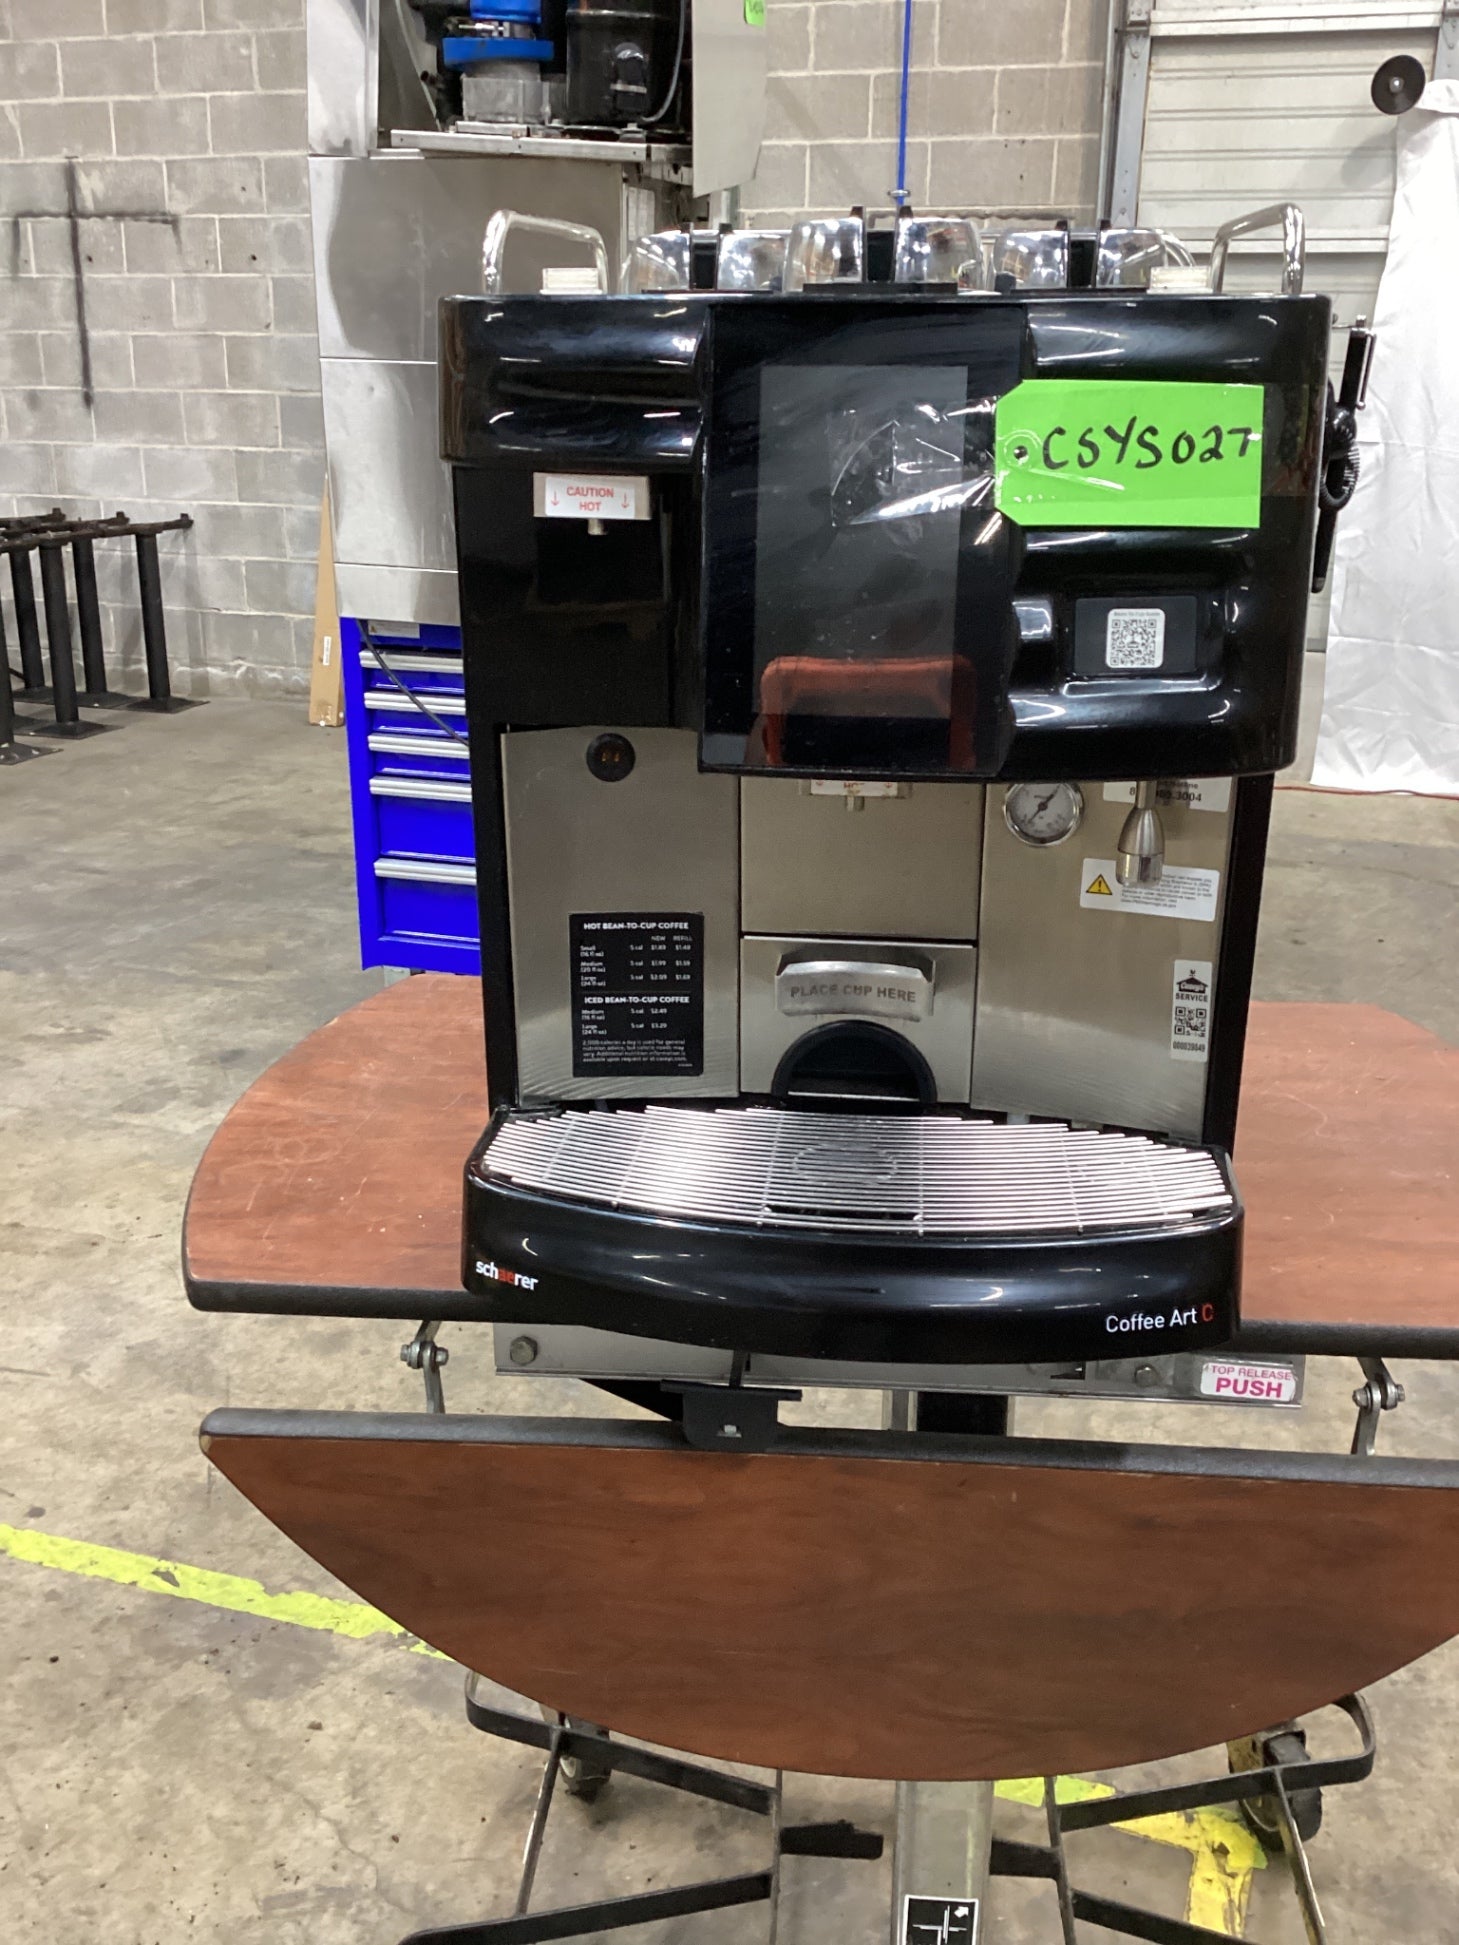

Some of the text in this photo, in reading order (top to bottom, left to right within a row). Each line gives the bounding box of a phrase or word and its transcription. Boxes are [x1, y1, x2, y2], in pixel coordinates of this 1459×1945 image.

[566, 486, 615, 498] CAUTION
[579, 501, 602, 511] HOT
[583, 921, 689, 930] HOT BEAN-TO-CUP COFFEE
[659, 996, 690, 1004] COFFEE
[790, 984, 916, 1002] PLACE CUP HERE
[1175, 992, 1208, 1003] SERVICE
[475, 1261, 539, 1290] schaerer
[1106, 1303, 1214, 1332] Coffee Art C
[1211, 1364, 1293, 1381] TOP RELEASE
[1215, 1377, 1283, 1398] PUSH
